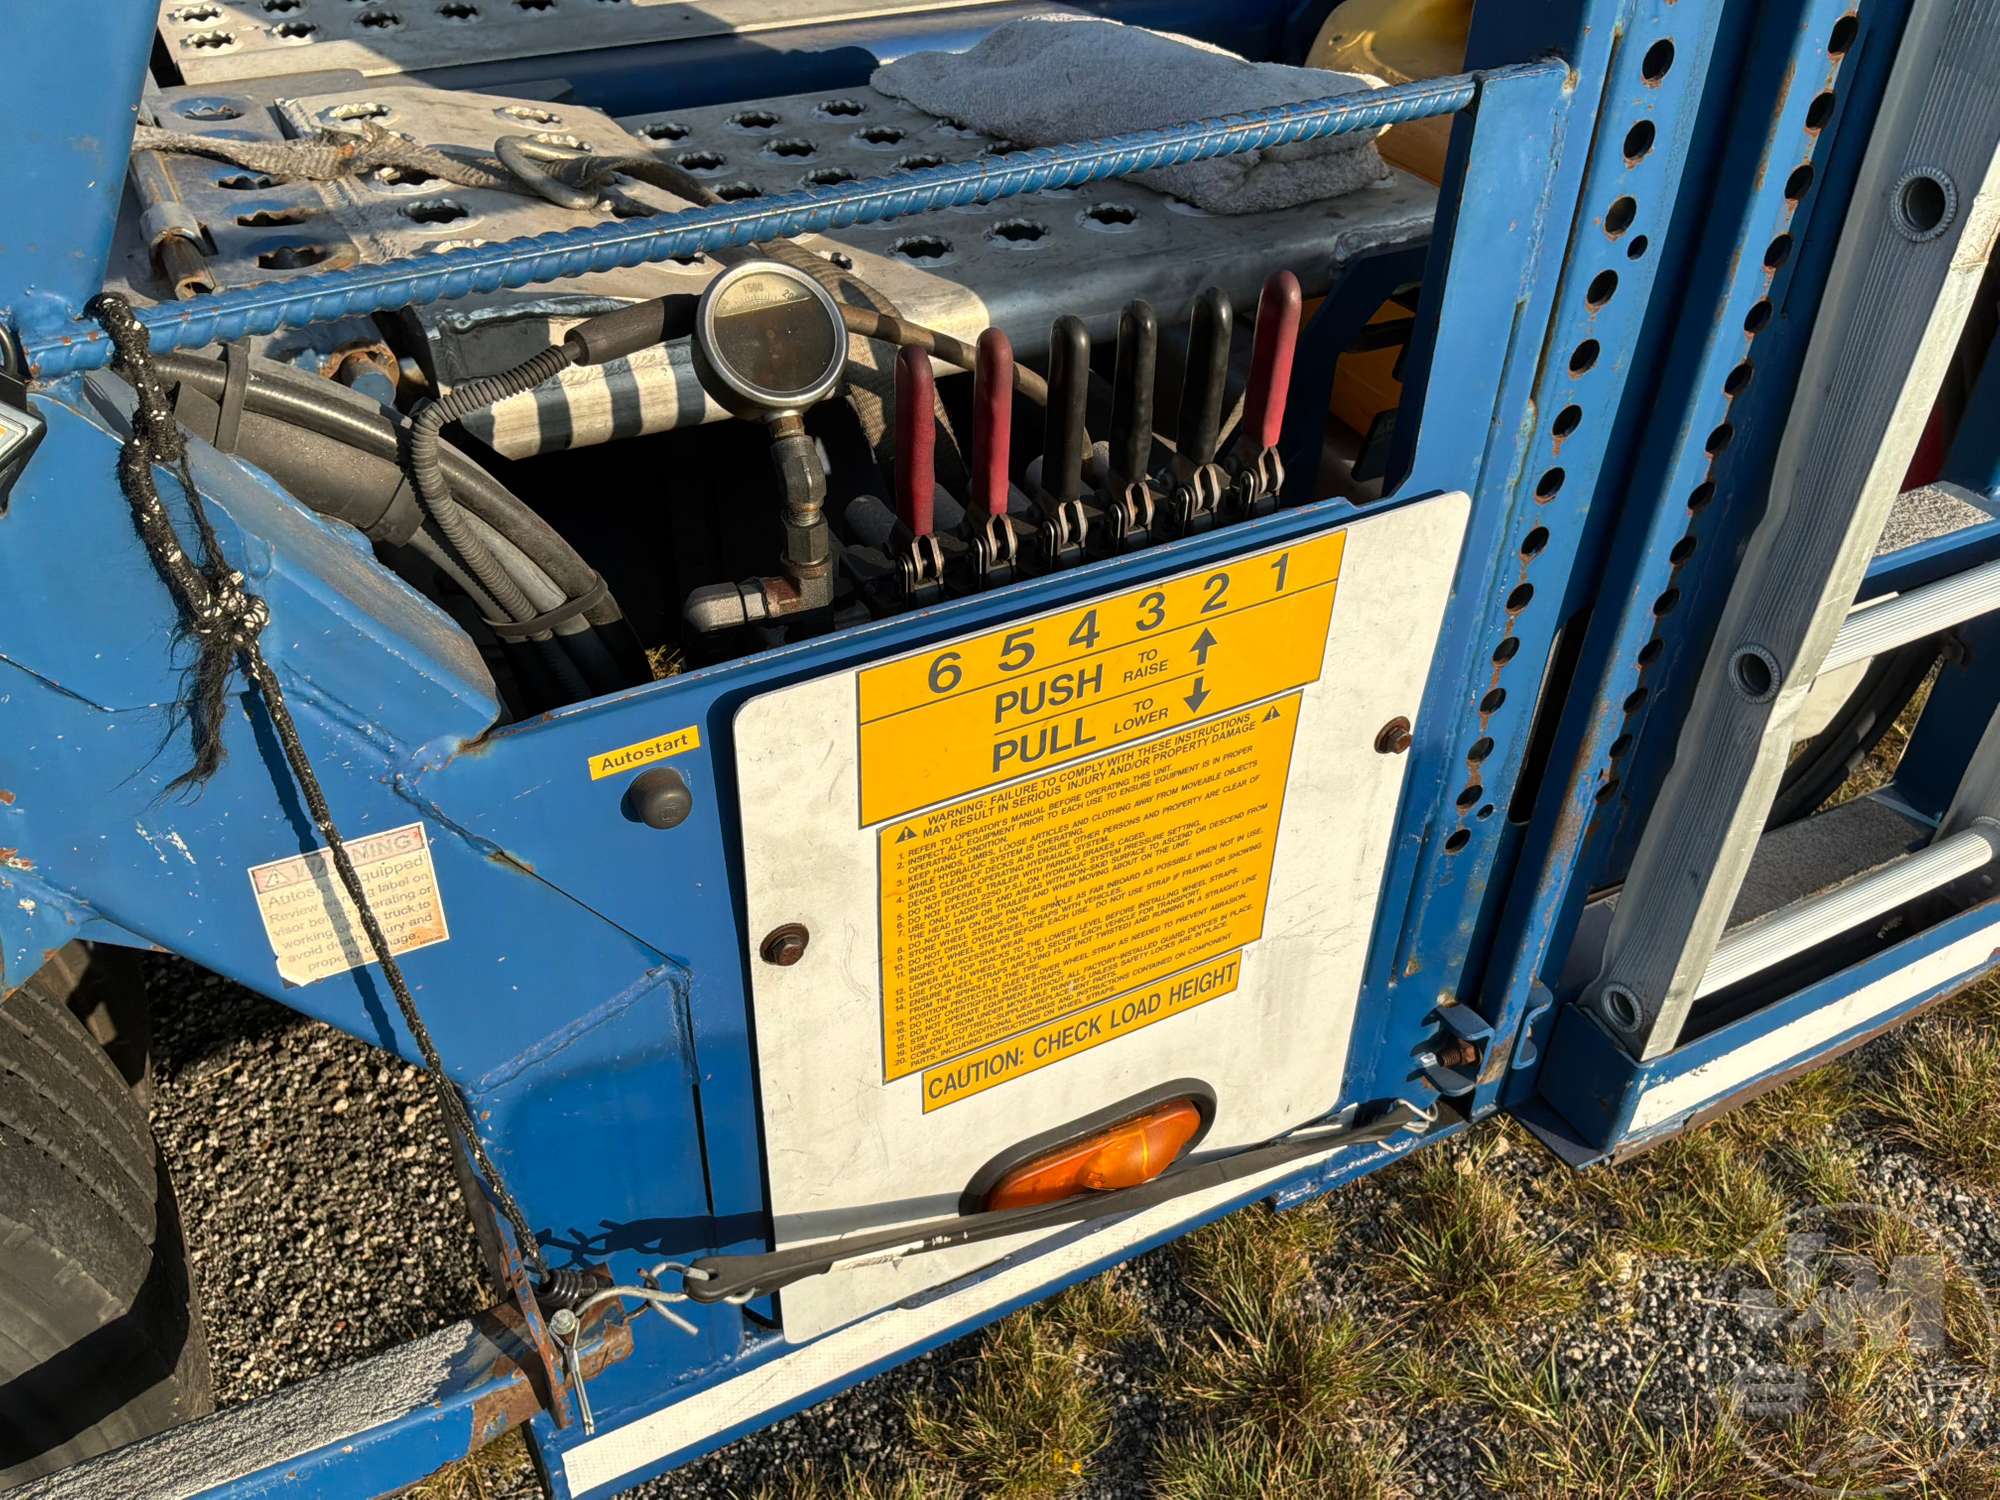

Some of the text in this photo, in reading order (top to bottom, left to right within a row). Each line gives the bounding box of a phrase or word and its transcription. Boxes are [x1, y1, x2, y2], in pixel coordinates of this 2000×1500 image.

[928, 553, 1289, 694] 6 5 4 3 2 1
[1123, 659, 1168, 683] RAISE
[1138, 648, 1158, 664] TO
[994, 663, 1103, 724] PUSH
[1134, 698, 1153, 713] TO
[1113, 708, 1168, 734] LOWER
[602, 734, 688, 771] Autostart
[992, 717, 1096, 773] PULL
[922, 721, 1256, 838] MAY RESULT IN SERIOUS INJURY AND/OR PROPERTY DAMAGE
[928, 712, 1250, 826] WARNING: FAILURE TO COMPLY WITH THESE INSTRUCTIONS
[357, 855, 424, 882] quipped
[378, 877, 409, 893] label
[412, 873, 429, 883] on
[383, 904, 415, 919] truck
[287, 944, 323, 962] avoid
[408, 912, 432, 926] and
[928, 961, 1237, 1099] CAUTION: CHECK LOAD HEIGHT
